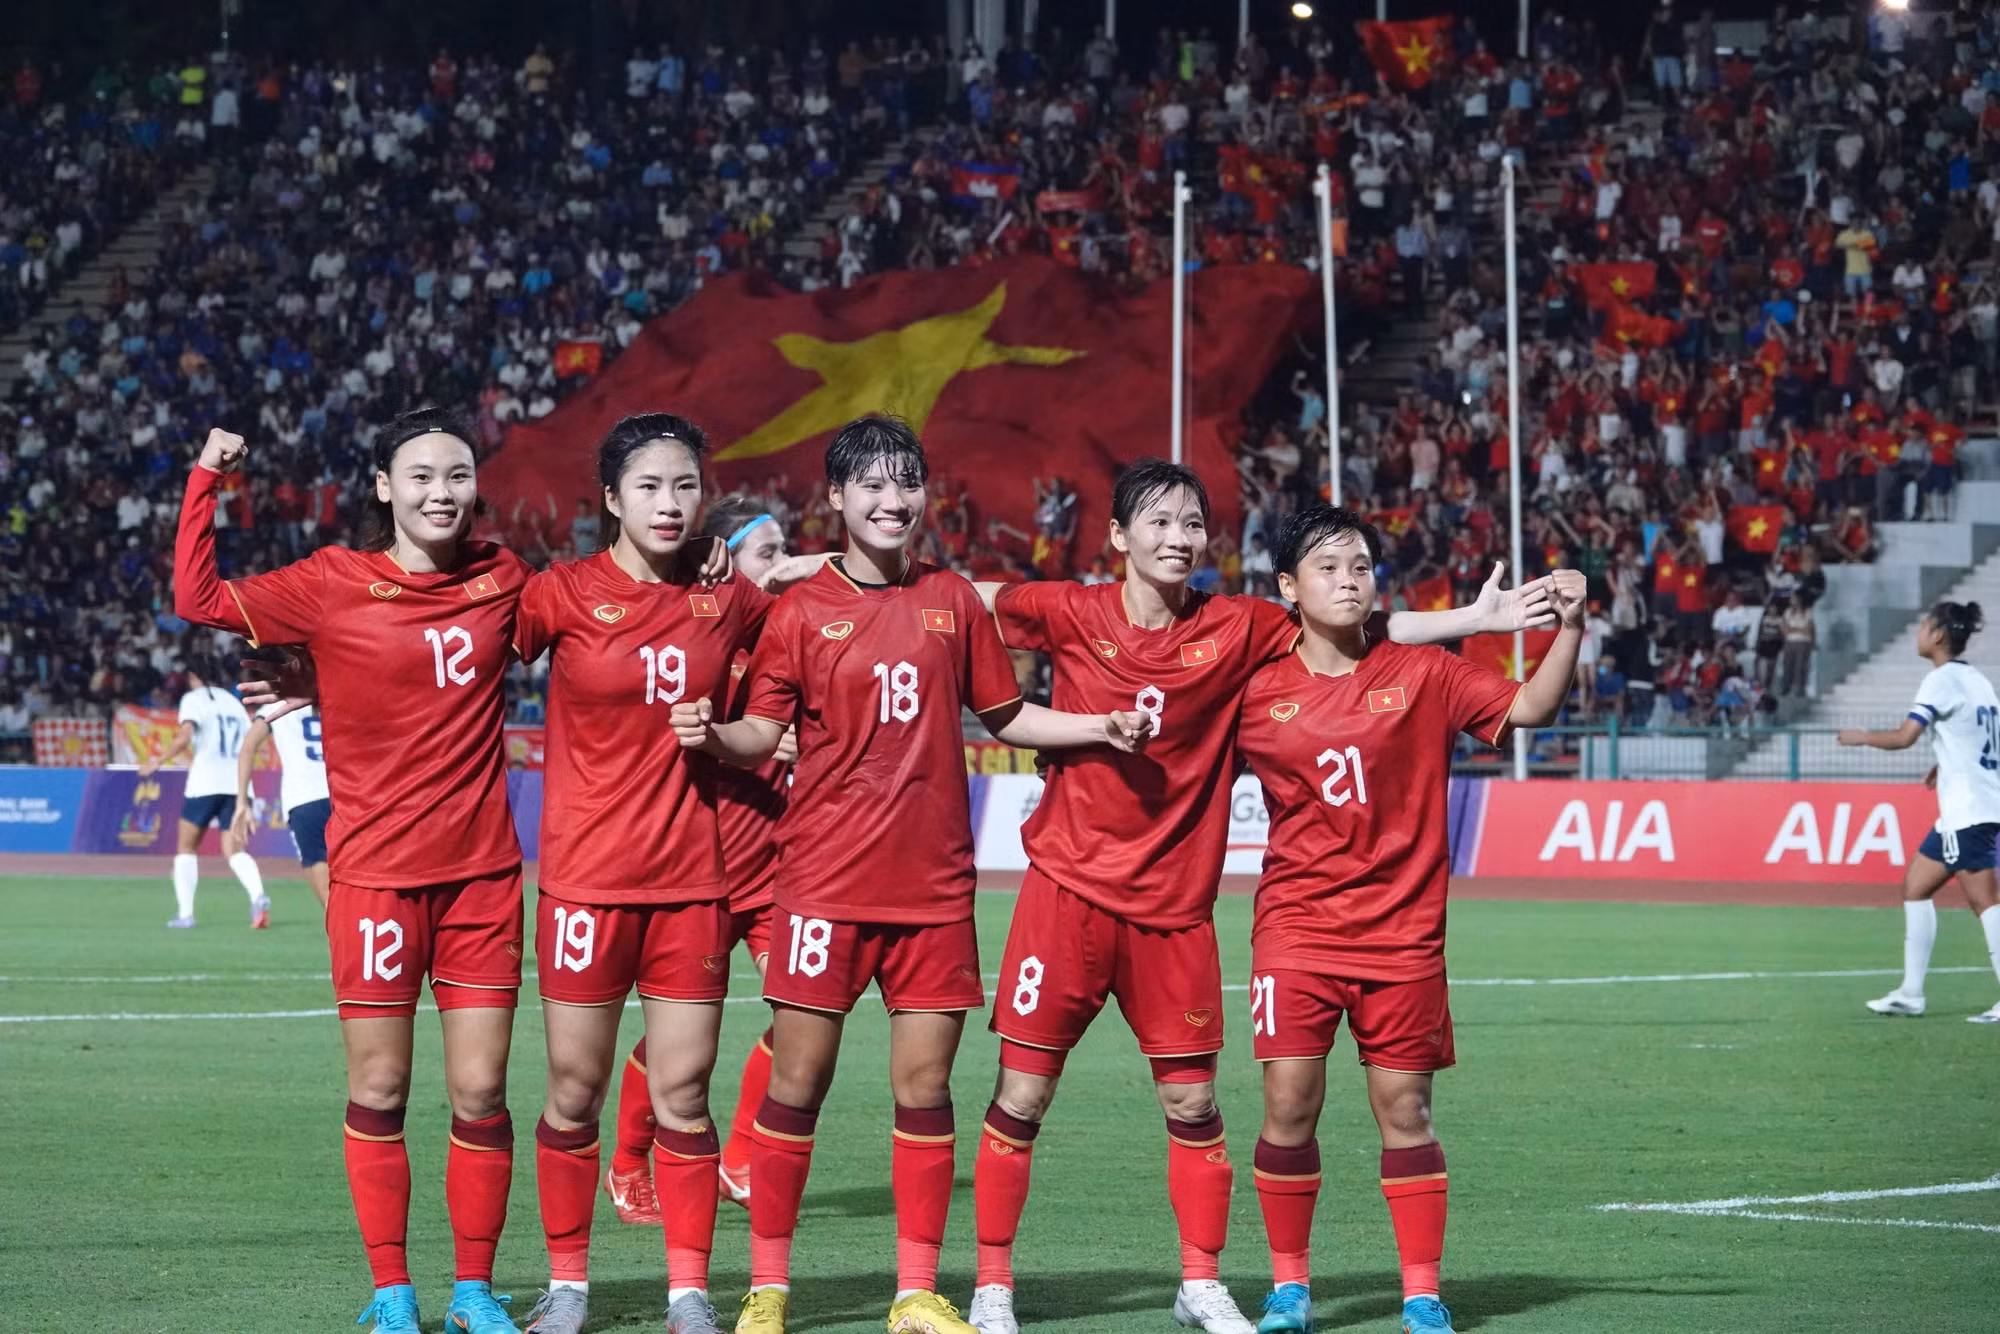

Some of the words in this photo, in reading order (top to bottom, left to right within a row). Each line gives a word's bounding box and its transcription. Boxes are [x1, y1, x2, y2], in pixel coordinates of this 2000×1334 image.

[424, 625, 476, 688] 12
[639, 644, 687, 705] 19
[873, 660, 919, 724] 18
[1135, 684, 1166, 737] 8
[1316, 745, 1368, 808] 21
[1539, 800, 1675, 861] AIA
[1764, 801, 1905, 866] AIA
[359, 917, 404, 982] 12
[554, 906, 596, 973] 19
[788, 914, 833, 978] 18
[1012, 955, 1045, 1017] 8
[1251, 974, 1276, 1037] 21
